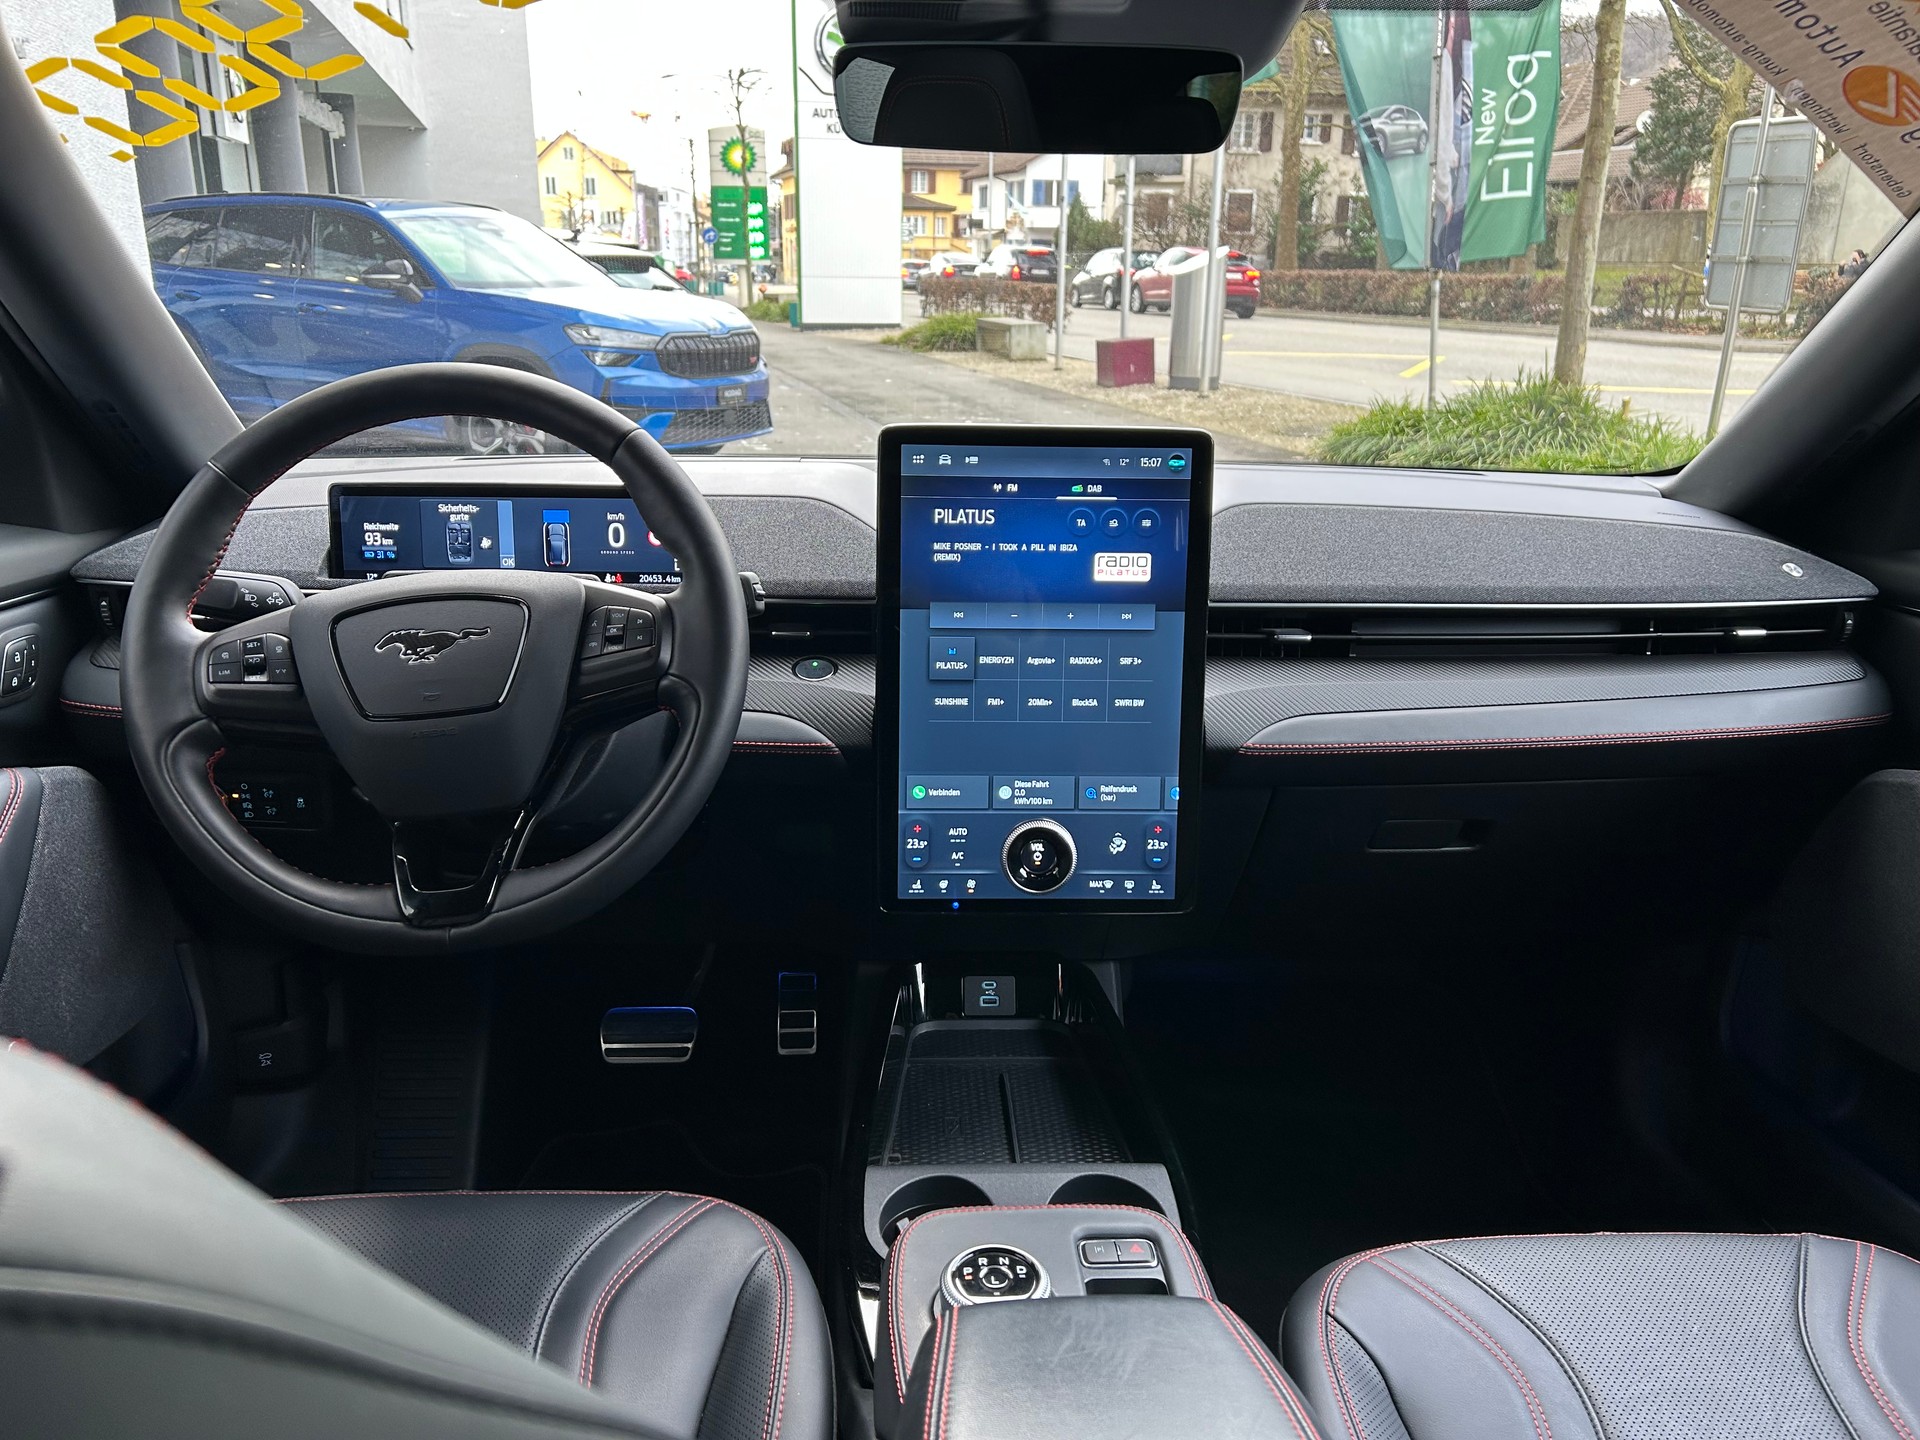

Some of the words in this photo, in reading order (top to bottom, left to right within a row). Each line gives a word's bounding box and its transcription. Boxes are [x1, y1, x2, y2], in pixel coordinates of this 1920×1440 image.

[1474, 88, 1497, 146] New
[1480, 51, 1552, 202] Elroq
[1140, 457, 1162, 468] 15:07
[1007, 483, 1018, 492] FM
[1087, 484, 1103, 493] DAB
[437, 503, 480, 513] Sicherheits-
[606, 512, 625, 521] km/h
[934, 508, 996, 525] PILATUS
[363, 522, 400, 532] Reichweite
[1076, 518, 1087, 528] TA
[364, 531, 382, 547] 93
[382, 537, 394, 546] km
[607, 522, 626, 548] 0
[933, 542, 952, 551] MIKE
[954, 542, 982, 551] POSNER
[999, 543, 1019, 552] TOOK
[1021, 543, 1028, 552] A
[1030, 543, 1046, 552] PILL
[1048, 543, 1057, 552] IN
[1059, 543, 1078, 552] IBIZA
[376, 550, 385, 559] 31
[933, 552, 962, 563] (REMIX)
[502, 557, 515, 567] OK
[639, 574, 671, 583] 20453.4
[979, 656, 1015, 664] ENERGYZH
[1069, 656, 1103, 665] RADIO24+
[1119, 657, 1132, 665] SRF
[936, 661, 968, 670] PILATUS+
[934, 697, 969, 706] SUNSHINE
[1133, 699, 1145, 707] BW
[1014, 780, 1032, 788] Diese
[1032, 780, 1050, 788] Fahrt
[1100, 784, 1138, 793] Reifendruck
[928, 788, 961, 797] Verbinden
[1014, 789, 1026, 797] 0.0
[1014, 797, 1042, 805] kWh/100
[1042, 797, 1053, 805] km
[1100, 793, 1117, 802] (bar)
[948, 827, 968, 836] AUTO
[1030, 842, 1045, 852] VOL
[951, 851, 964, 860] A/C
[1089, 880, 1104, 889] MAX
[978, 1257, 988, 1266] R
[999, 1256, 1010, 1266] N
[963, 1267, 973, 1275] P
[1016, 1266, 1027, 1274] D
[990, 1276, 1000, 1284] L
